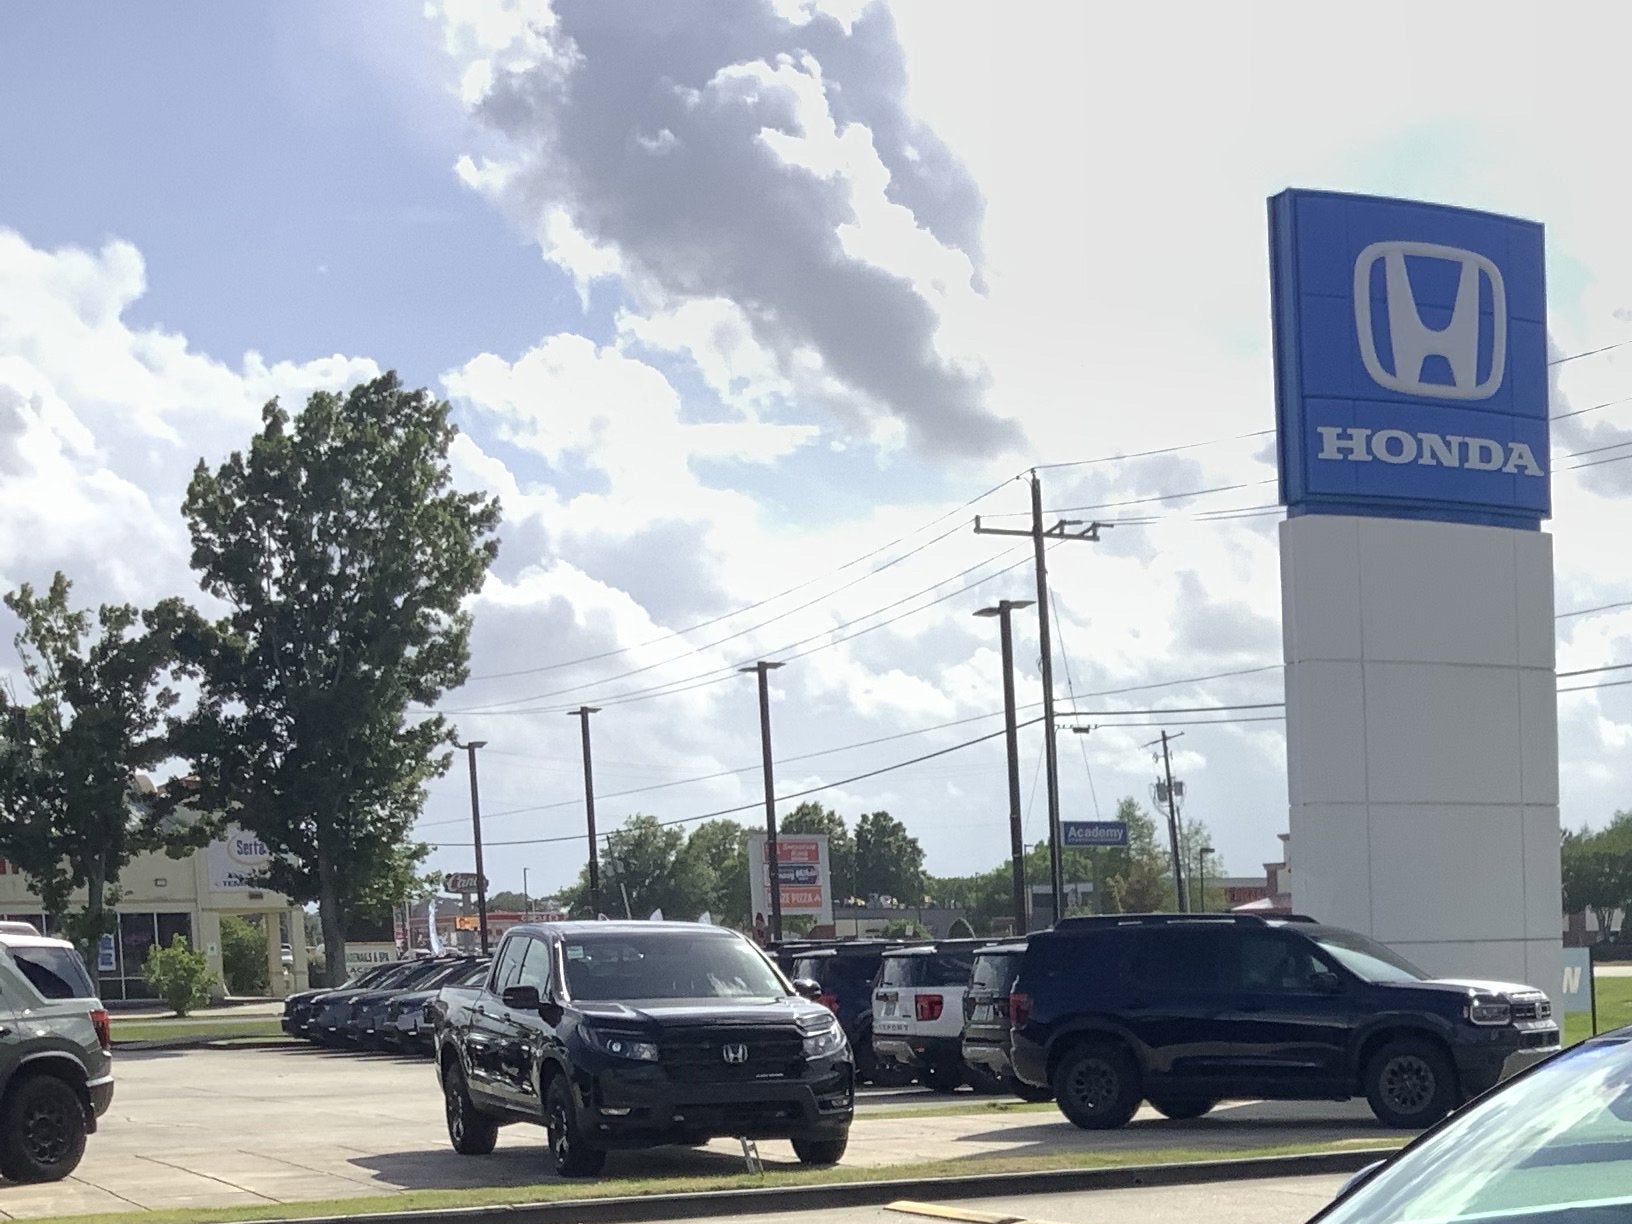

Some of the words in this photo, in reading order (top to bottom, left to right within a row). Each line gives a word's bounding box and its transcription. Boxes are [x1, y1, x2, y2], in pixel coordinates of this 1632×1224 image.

[1316, 426, 1545, 477] HONDA
[1068, 826, 1124, 840] Academy
[236, 840, 267, 856] Serta
